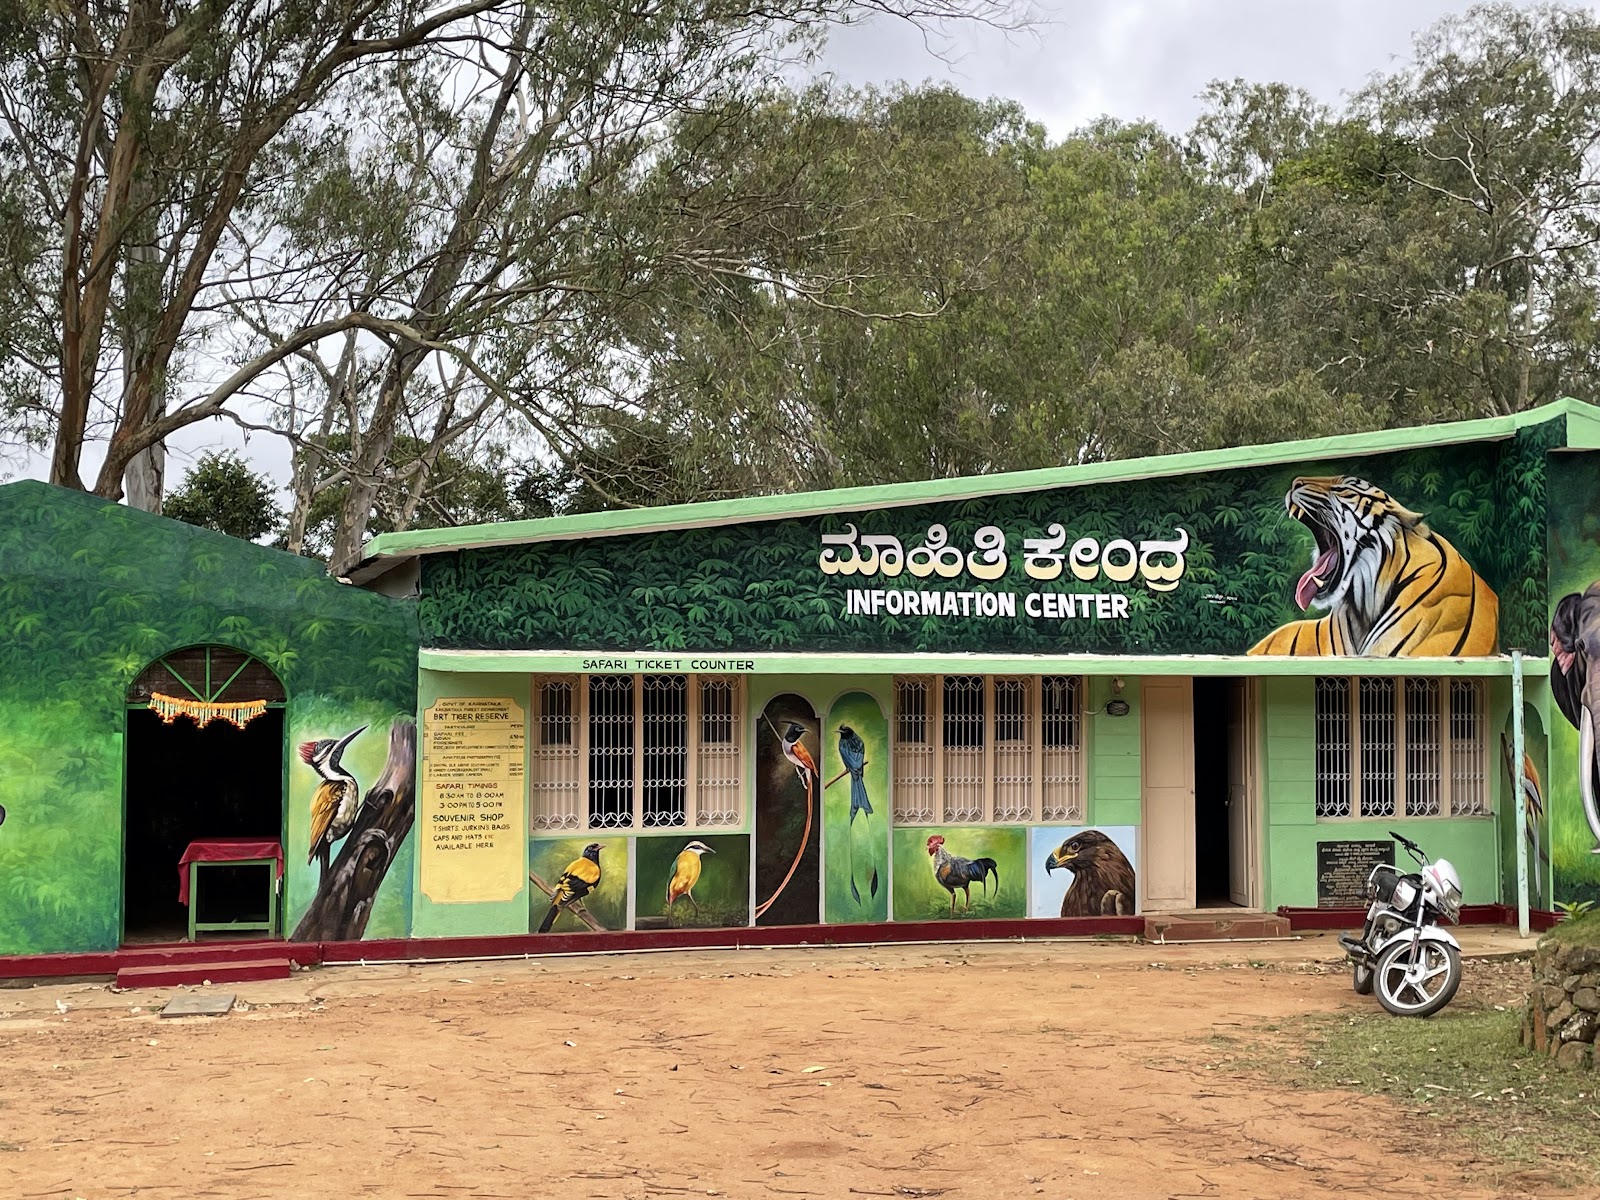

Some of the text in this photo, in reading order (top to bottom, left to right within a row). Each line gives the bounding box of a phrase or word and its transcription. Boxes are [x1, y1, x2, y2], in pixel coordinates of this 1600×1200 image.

[819, 523, 1190, 592] ಮಾಹಿತಿ ಕೇಂದ್ರ
[847, 588, 1130, 619] INFORMATION CENTER
[582, 660, 755, 671] SAFARI TICKET COUNTER
[433, 713, 448, 721] BRT
[451, 713, 474, 721] TIGER
[475, 712, 509, 720] RESERVE
[432, 813, 504, 822] SOUVENIR SHOP
[433, 834, 450, 842] CAPS
